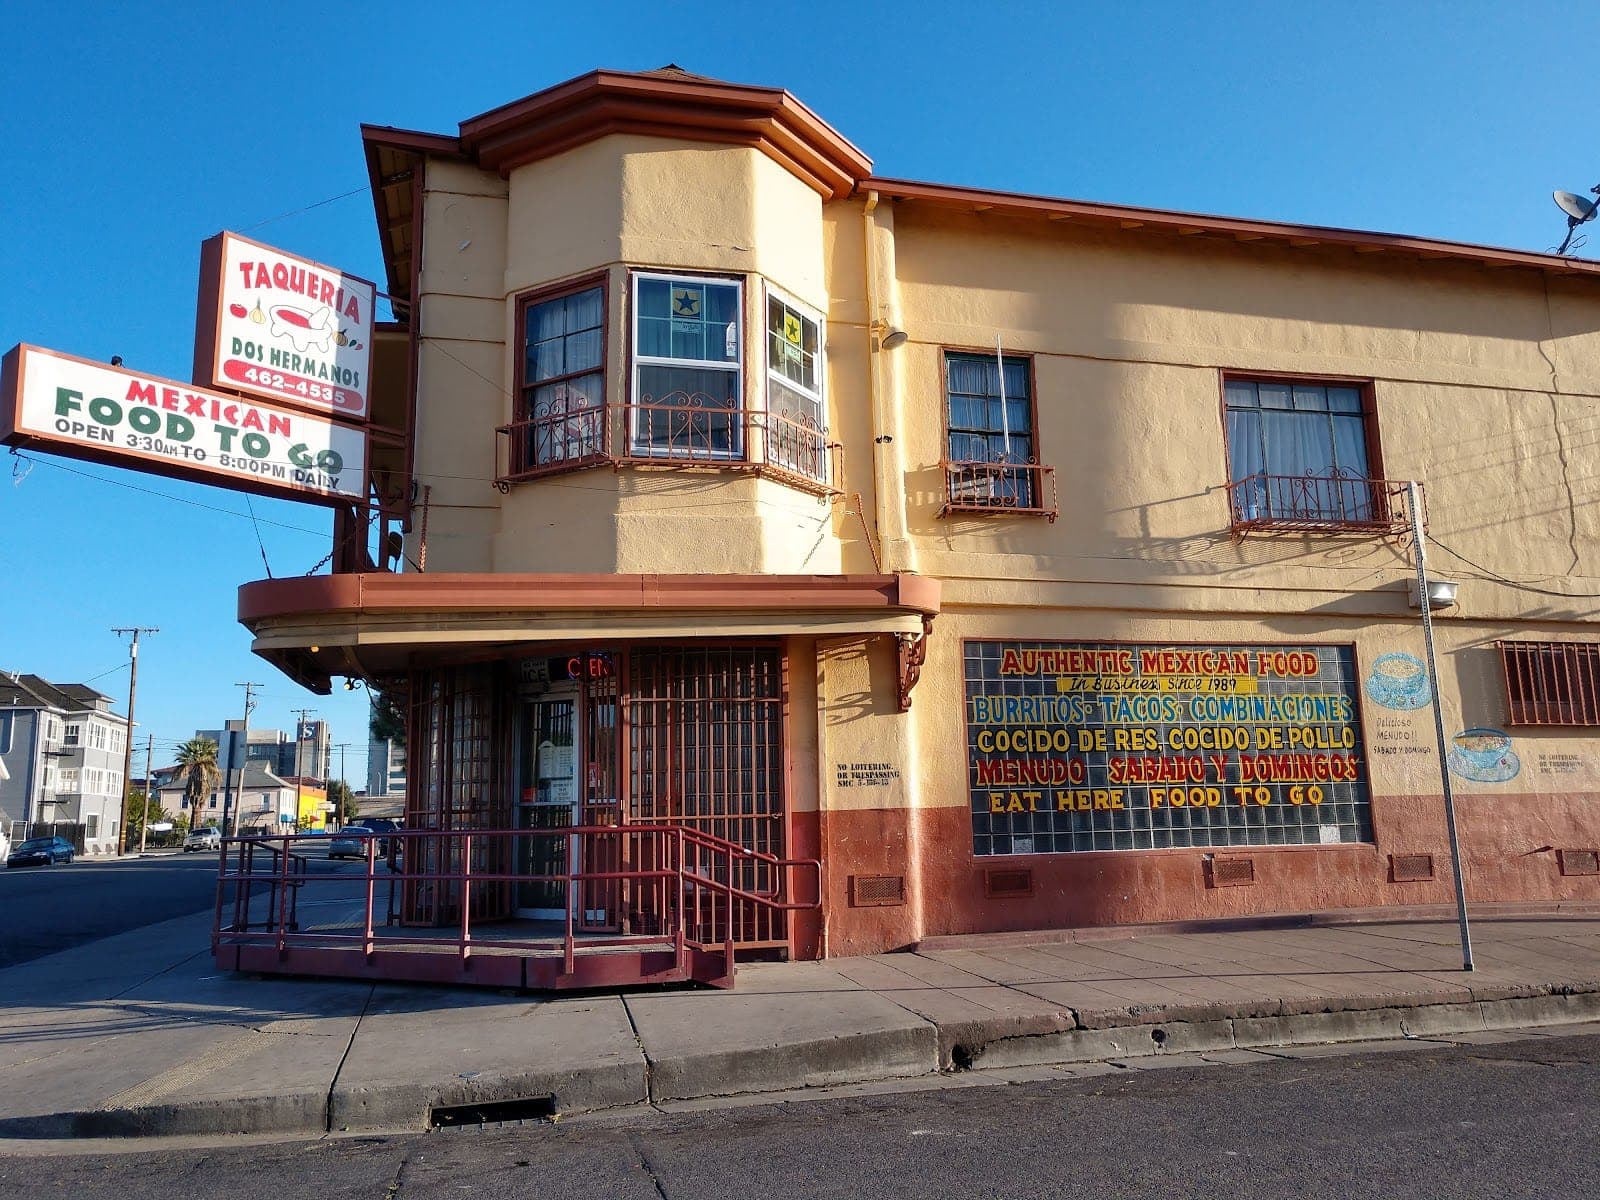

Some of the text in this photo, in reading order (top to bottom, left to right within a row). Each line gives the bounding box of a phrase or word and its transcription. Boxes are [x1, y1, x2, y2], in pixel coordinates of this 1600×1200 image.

[239, 261, 361, 325] TAQUERIA
[232, 337, 360, 388] DOS HERMANOS
[244, 368, 345, 404] 462-4535
[126, 380, 291, 437] MEXICAN
[55, 387, 343, 474] FOOD TO GO
[55, 418, 340, 489] OPEN 3:30AM TO 8:00PM DAILY
[1001, 649, 1318, 676] AUTHENTIC MEXICAN FOOD
[1070, 678, 1088, 691] In
[1168, 677, 1202, 691] Since
[1208, 678, 1237, 691] 1989
[974, 695, 1353, 724] BURRITOS TACOS COMBINACIONES
[977, 726, 1356, 753] COCIDO DE RES, COCIDO DE POLLO
[851, 771, 900, 779] TRESPASSING
[976, 754, 1359, 785] MENUDO SABADO Y DOMINGOS
[988, 785, 1325, 814] EAT HERE FOOD TO GO
